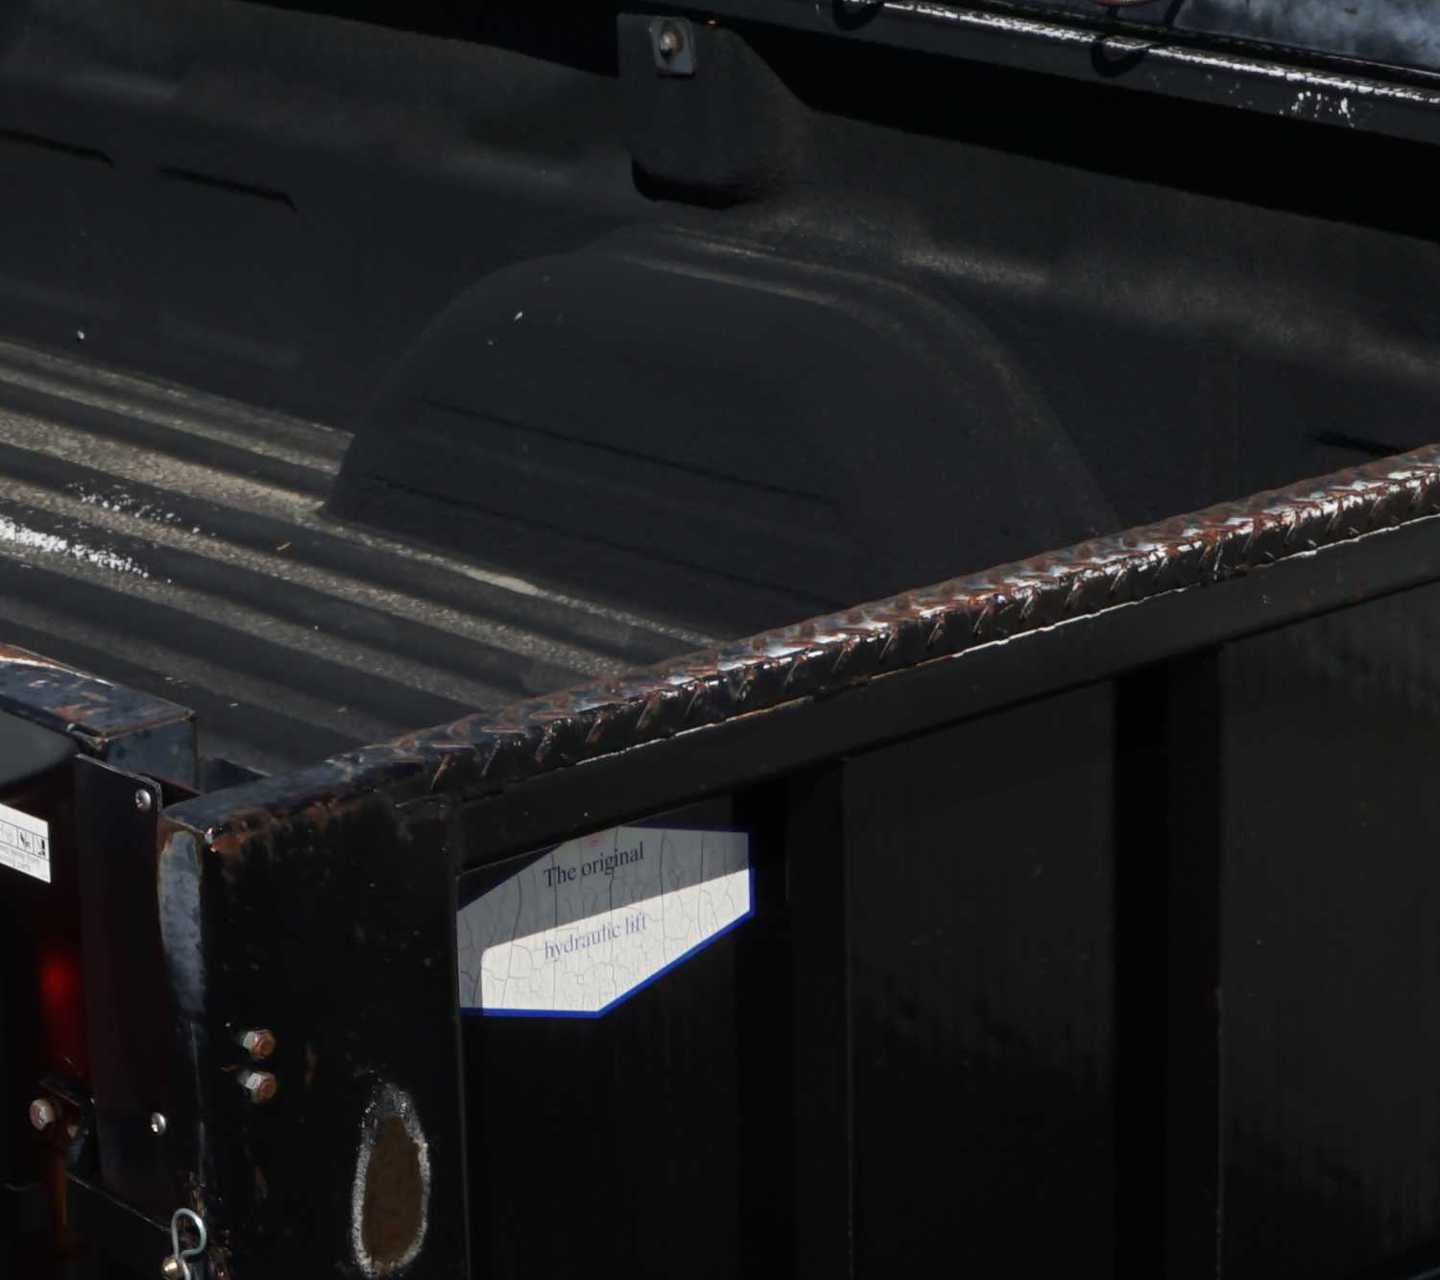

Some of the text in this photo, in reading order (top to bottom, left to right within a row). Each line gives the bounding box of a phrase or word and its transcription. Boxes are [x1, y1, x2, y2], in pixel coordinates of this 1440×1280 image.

[543, 840, 645, 888] The original
[625, 911, 648, 936] lift
